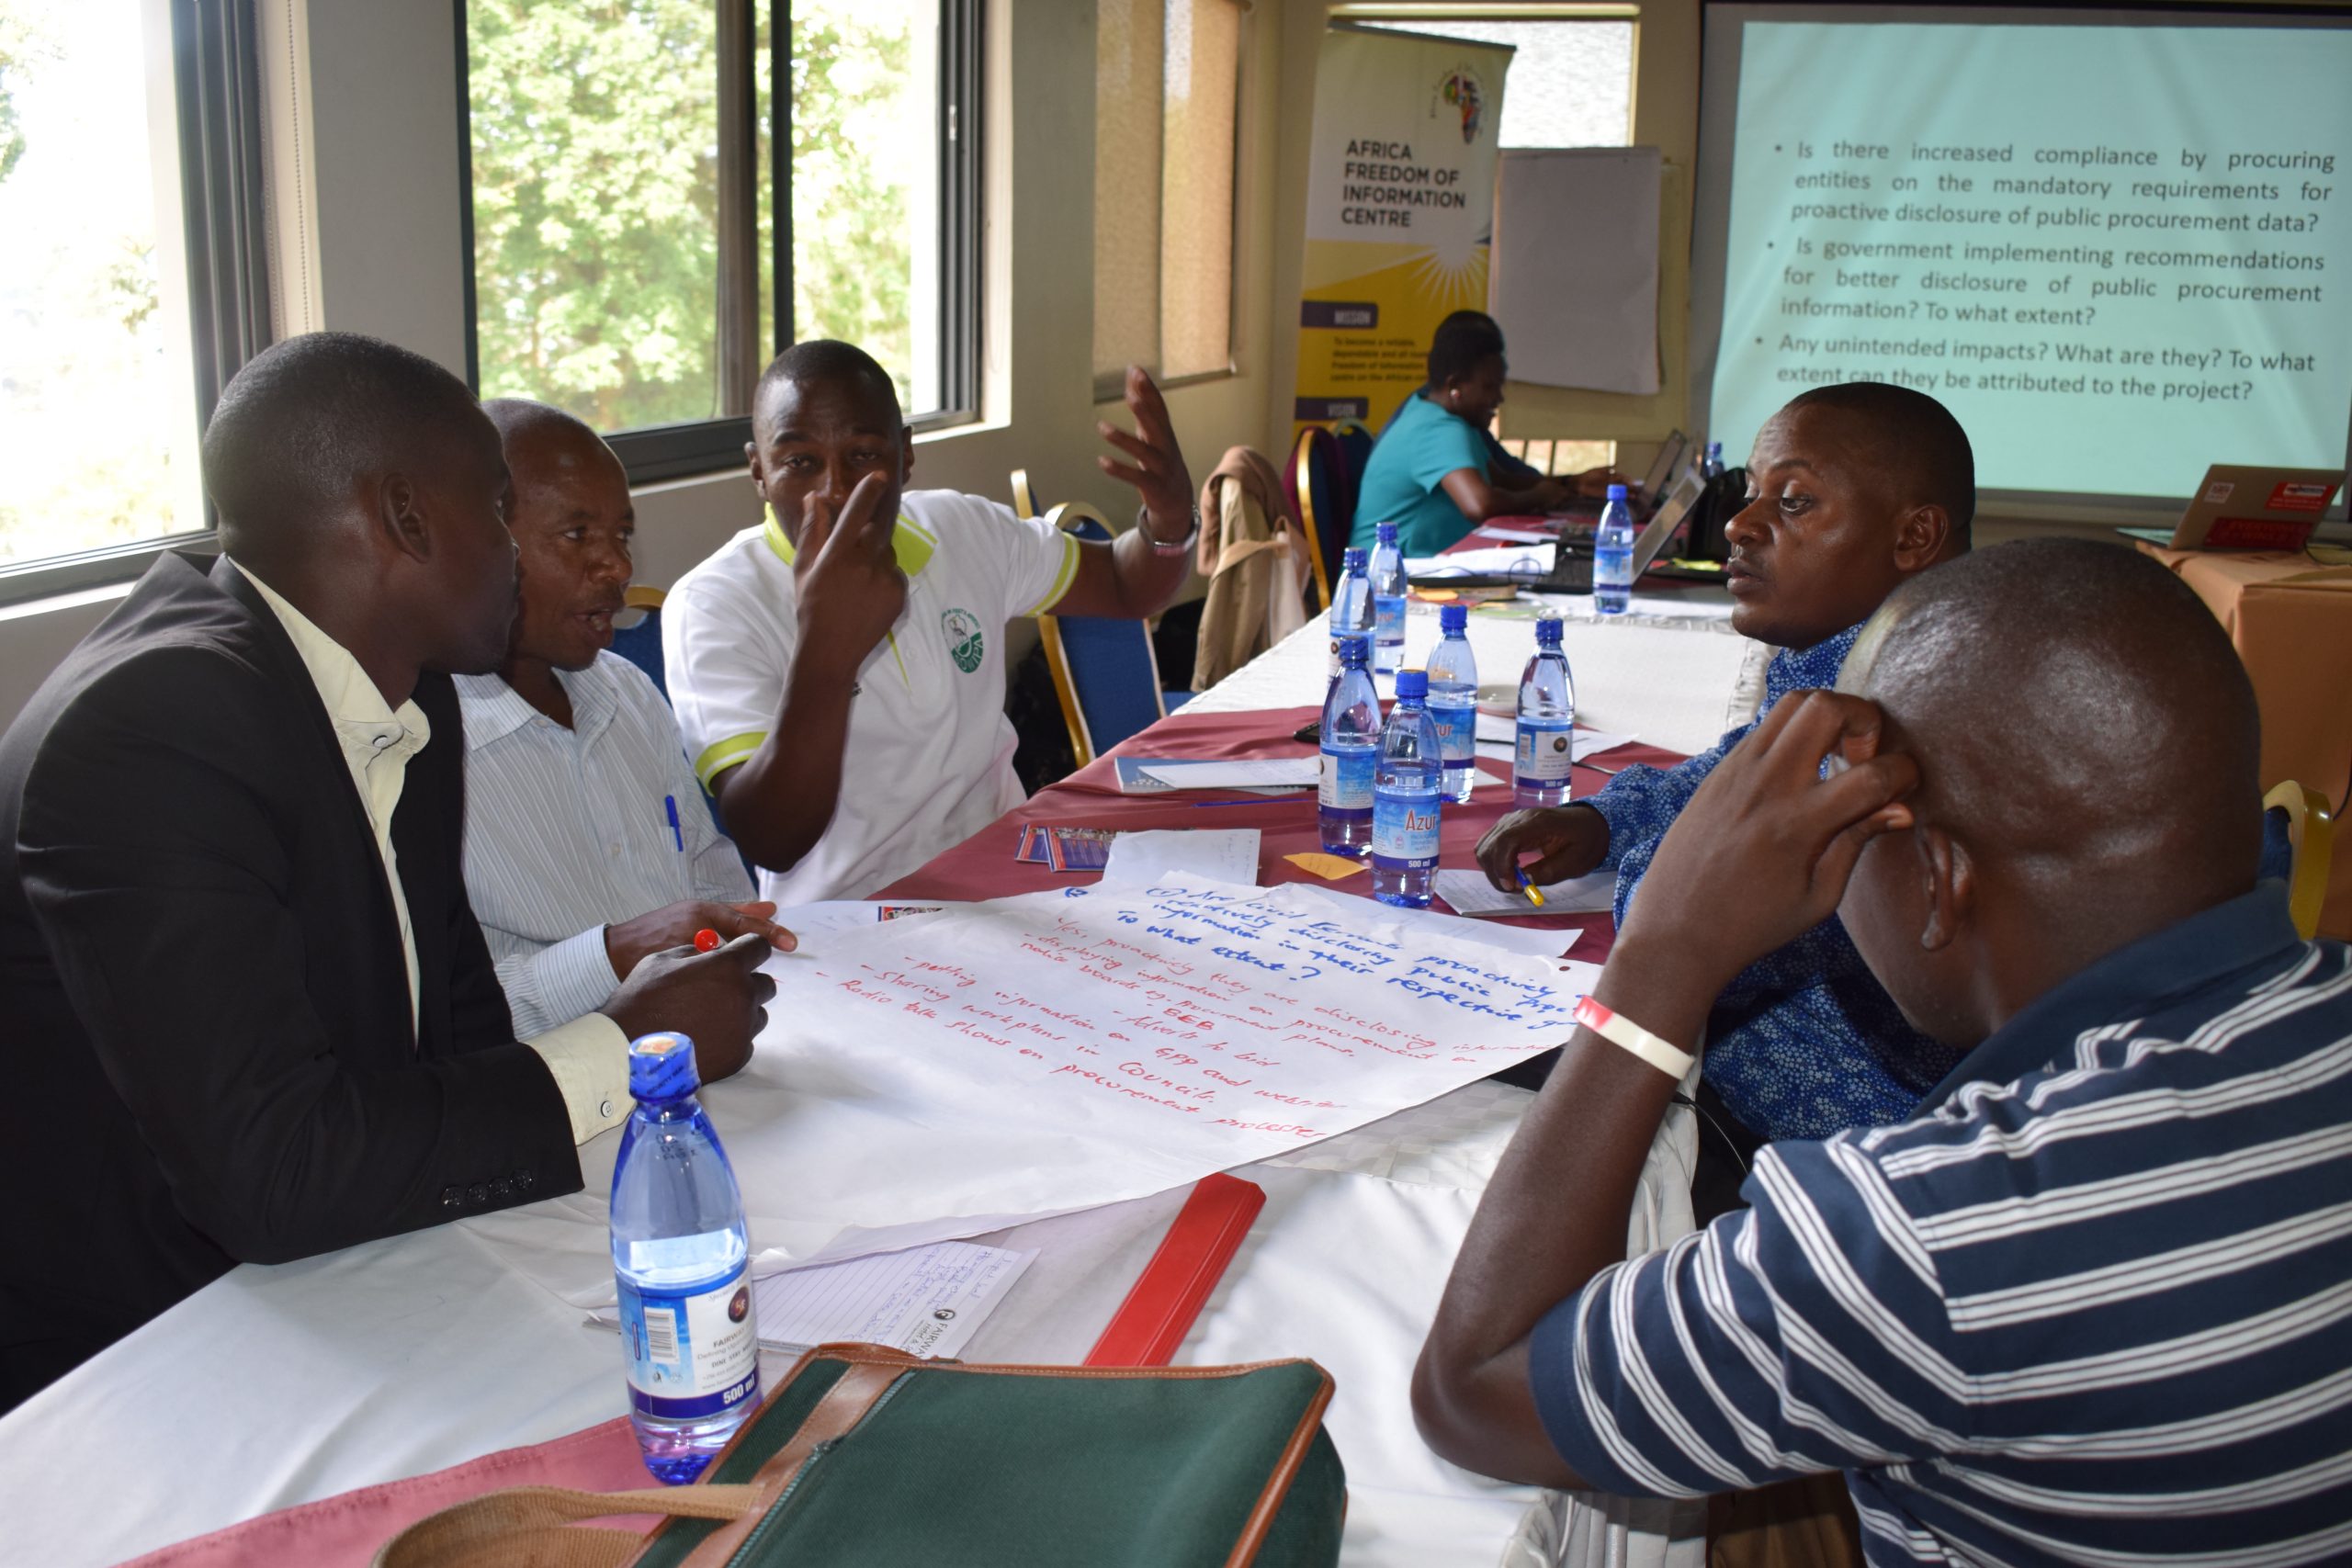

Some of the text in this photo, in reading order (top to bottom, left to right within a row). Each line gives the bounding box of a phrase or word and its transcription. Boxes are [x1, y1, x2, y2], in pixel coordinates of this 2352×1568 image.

[1346, 140, 1412, 161] AFRICA
[1798, 140, 2335, 175] Is there increased compliance by procuring
[1344, 162, 1459, 186] FREEDOM OF
[1794, 172, 2333, 201] entities on the mandatory requirements for
[1342, 186, 1465, 209] INFORMATION
[1341, 208, 1411, 227] CENTRE
[1791, 202, 2319, 232] proactive disclosure of public procurement data?
[1796, 237, 2325, 270] Is government implementing recommendations
[1783, 267, 2323, 303] for better disclosure of public procurement
[1781, 298, 2096, 326] information? To what extent?
[1778, 334, 2315, 372] Any unintended impacts? What are they? To what
[1777, 367, 2253, 403] extent can they be attributed to the project?
[1406, 809, 1436, 831] Azur
[1408, 858, 1430, 868] 500 ml
[1187, 891, 1235, 902] Are
[1117, 910, 1138, 923] To
[1146, 925, 1202, 945] what
[1211, 945, 1286, 971] extent
[1308, 949, 1374, 975] their
[1386, 976, 1523, 1021] respective
[1406, 965, 1490, 997] public
[1264, 992, 1298, 1005] are
[1314, 1007, 1437, 1050] disclosing
[837, 980, 893, 1004] Radio
[1019, 1047, 1043, 1059] on
[1049, 1064, 1200, 1114] procurement
[1202, 1068, 1252, 1088] and
[918, 1323, 948, 1358] FAIRWA
[722, 1385, 744, 1404] 500
[745, 1374, 756, 1393] ml
